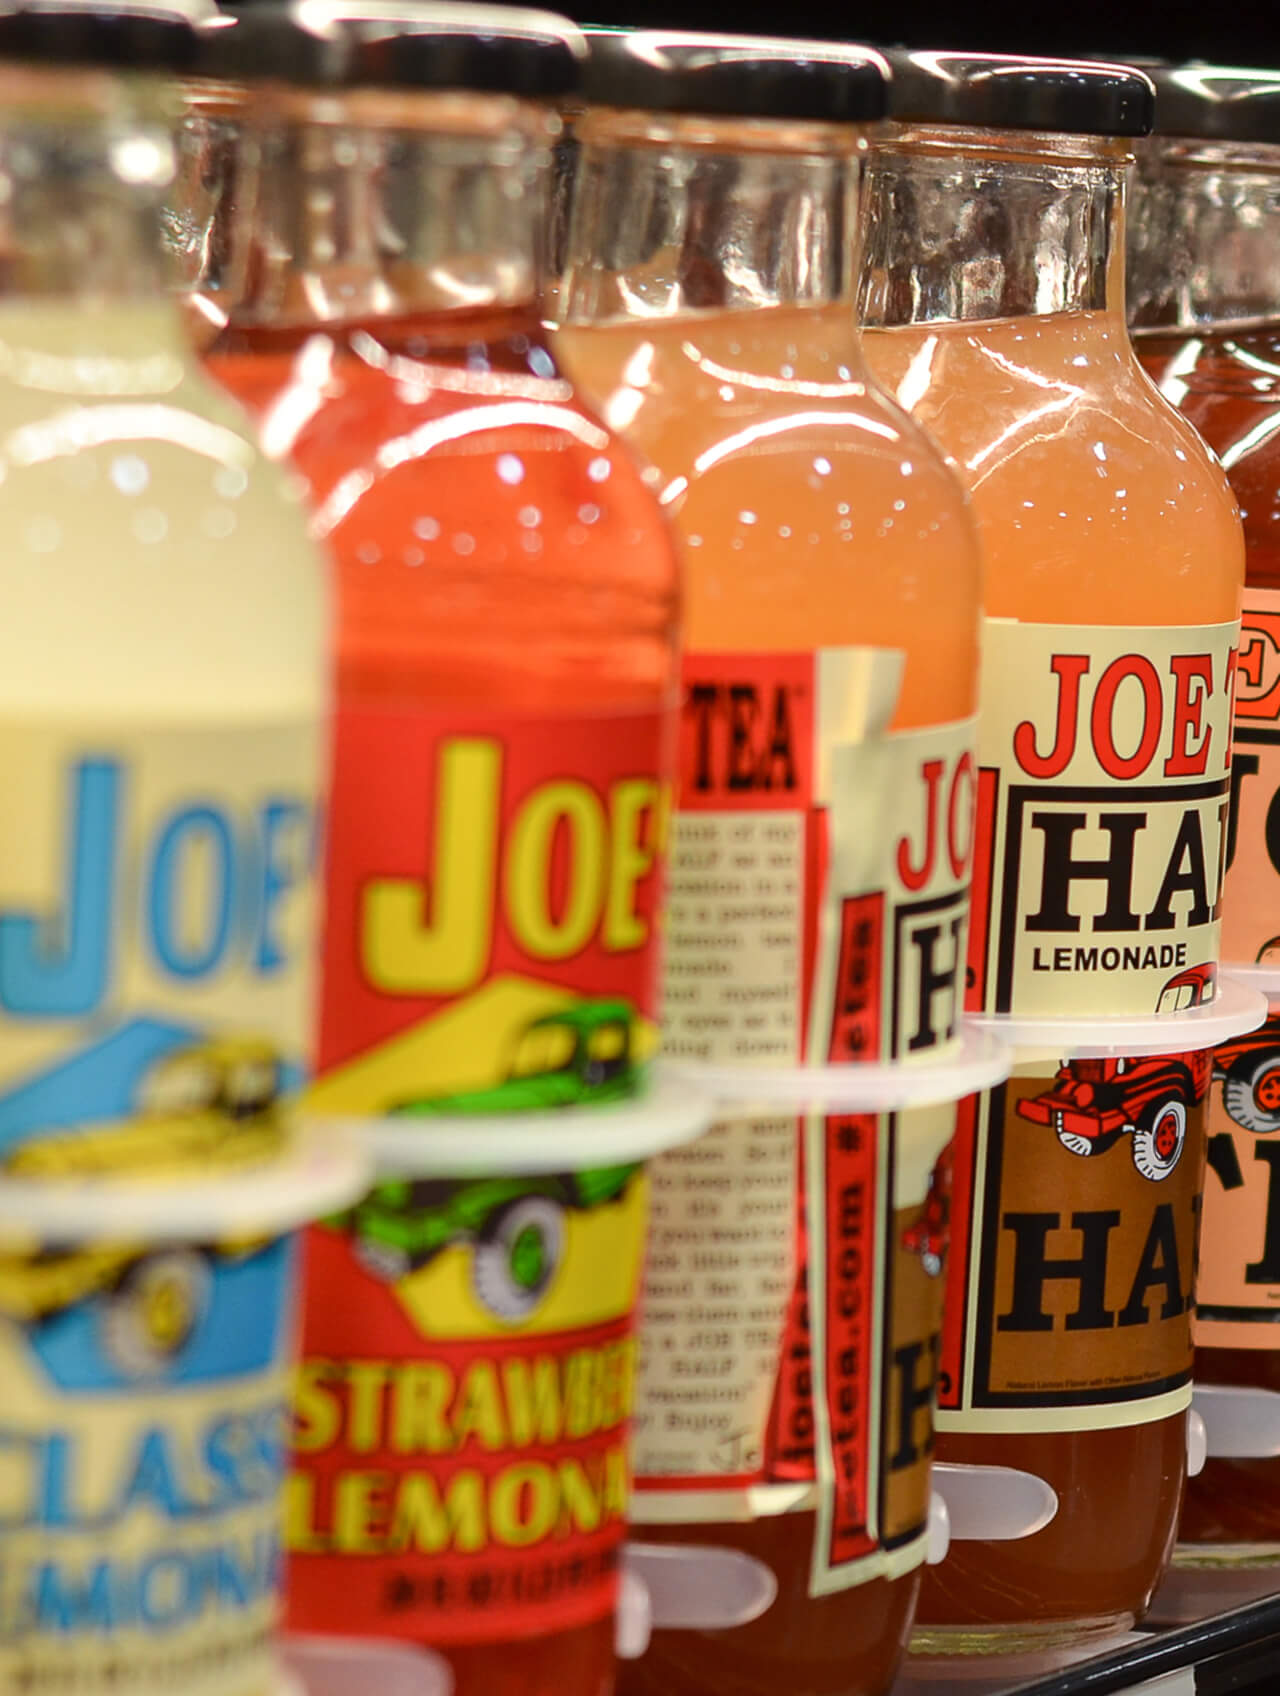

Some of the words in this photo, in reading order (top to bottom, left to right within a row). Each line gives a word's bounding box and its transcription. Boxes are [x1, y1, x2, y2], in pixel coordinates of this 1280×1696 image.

[685, 682, 798, 792] TEA
[1024, 808, 1229, 933] HA
[1032, 943, 1188, 972] LEMONADE
[996, 1193, 1203, 1332] HA
